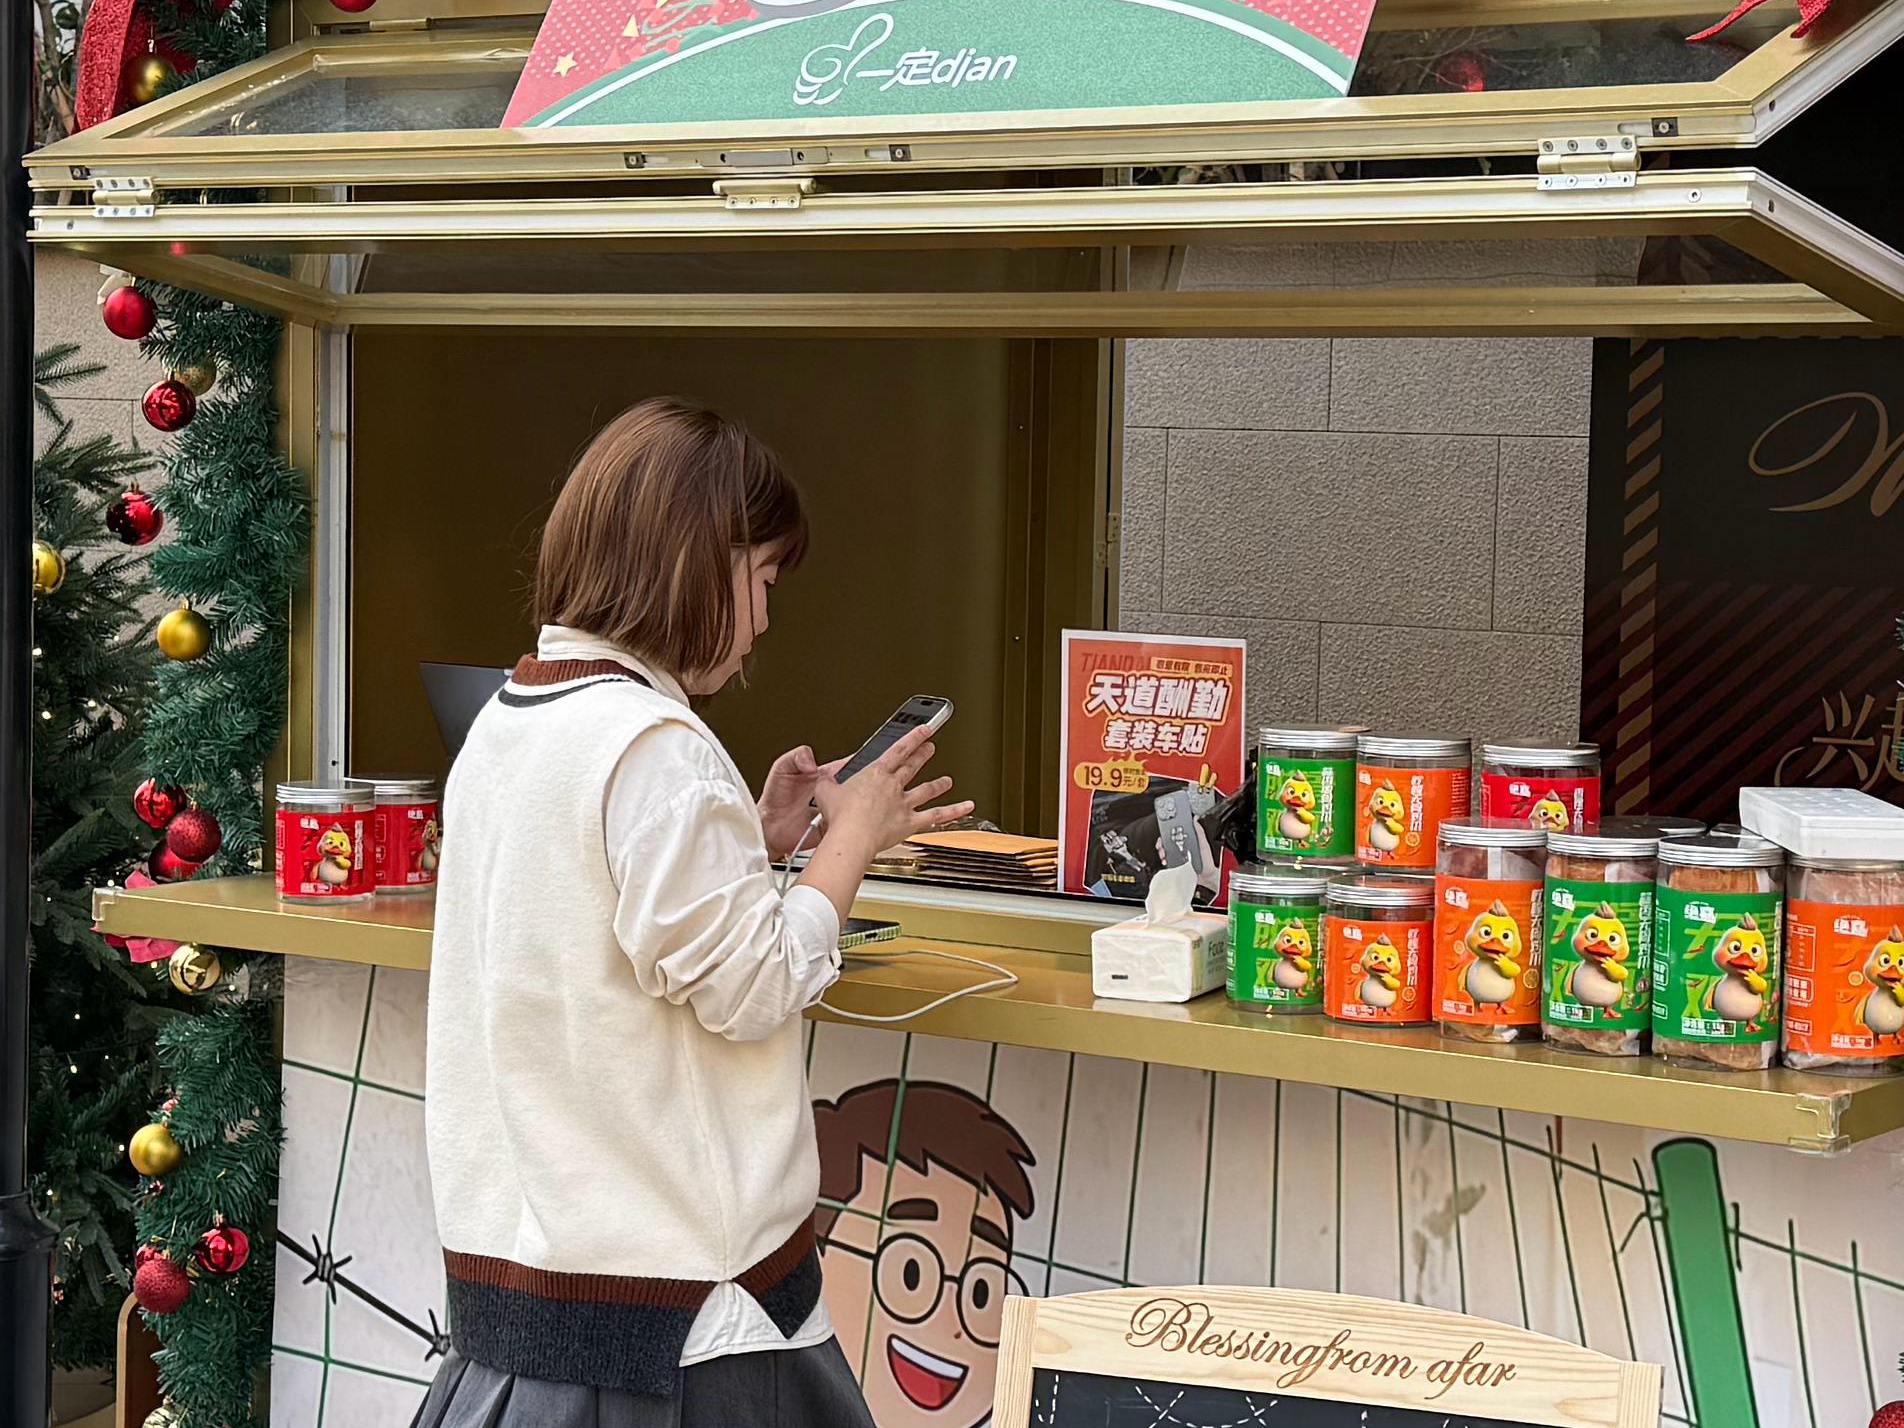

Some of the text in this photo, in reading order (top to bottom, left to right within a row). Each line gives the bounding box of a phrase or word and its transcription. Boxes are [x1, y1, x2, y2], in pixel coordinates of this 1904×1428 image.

[1086, 673, 1231, 722] 天道酬勤
[1104, 718, 1211, 755] 套装车贴
[1424, 1341, 1517, 1400] afar
